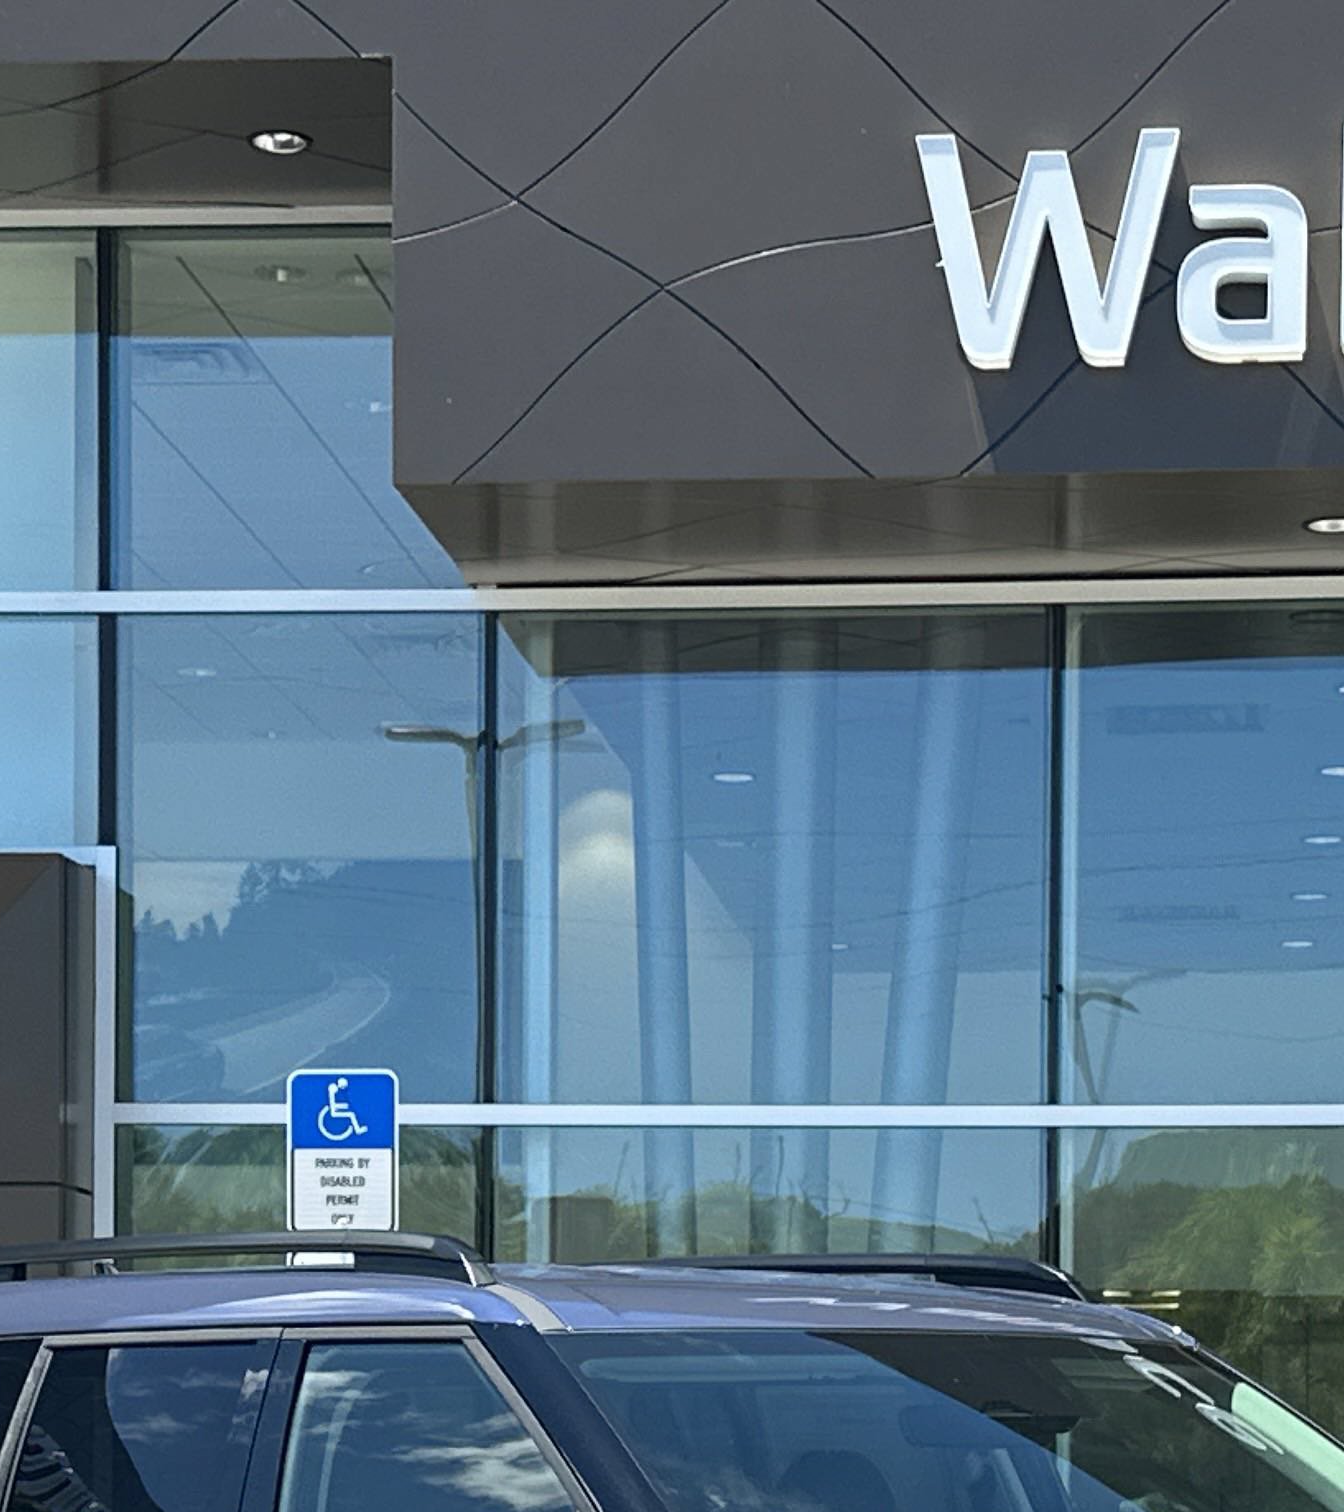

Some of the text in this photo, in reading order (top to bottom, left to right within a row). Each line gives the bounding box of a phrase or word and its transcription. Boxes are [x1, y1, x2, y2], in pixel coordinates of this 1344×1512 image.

[315, 1158, 371, 1169] PARKING BY
[320, 1175, 366, 1188] DISABLED
[325, 1194, 360, 1207] PERMIT
